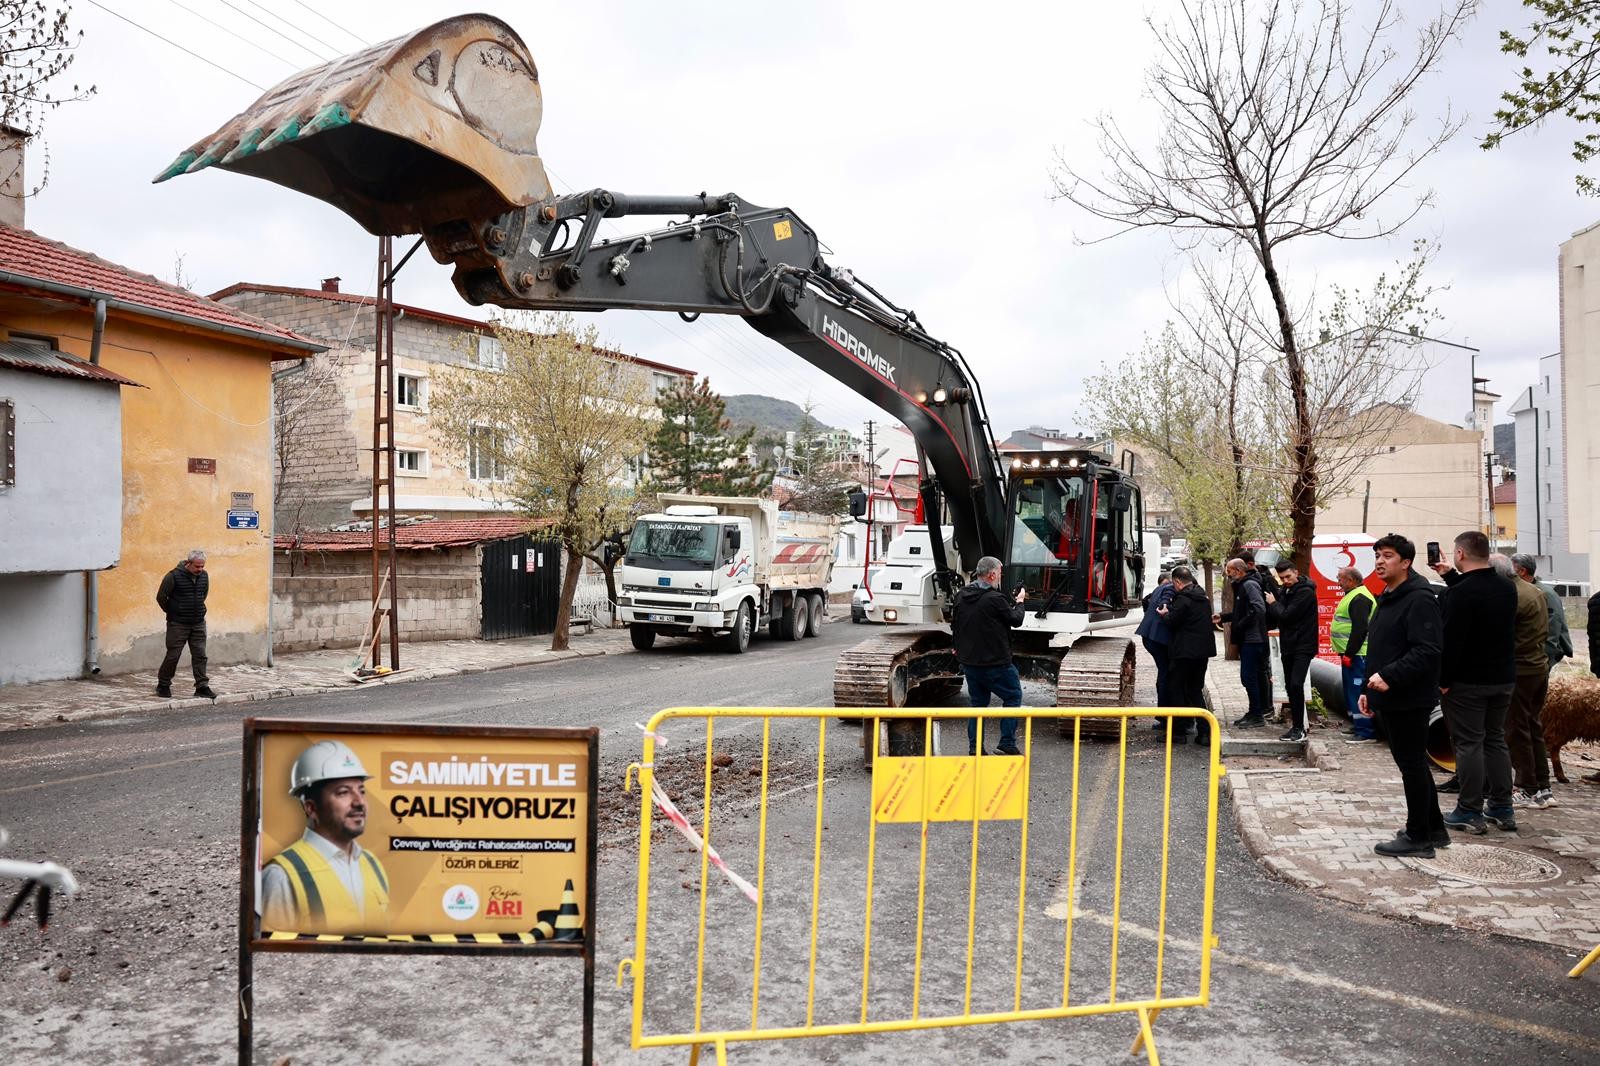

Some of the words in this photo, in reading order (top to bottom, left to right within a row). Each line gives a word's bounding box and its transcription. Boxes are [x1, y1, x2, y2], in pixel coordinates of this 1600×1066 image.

[389, 756, 577, 787] SAMİMİYETLE
[390, 795, 576, 825] ÇALIŞIYORUZ!
[392, 838, 431, 850] Çevreye
[432, 839, 476, 851] Verdiğimiz
[478, 840, 543, 850] Rahatsızlıktan
[544, 841, 572, 852] Dolayı
[445, 857, 476, 869] ÖZÜR
[478, 858, 520, 870] DİLERİZ
[485, 900, 522, 915] ARI
